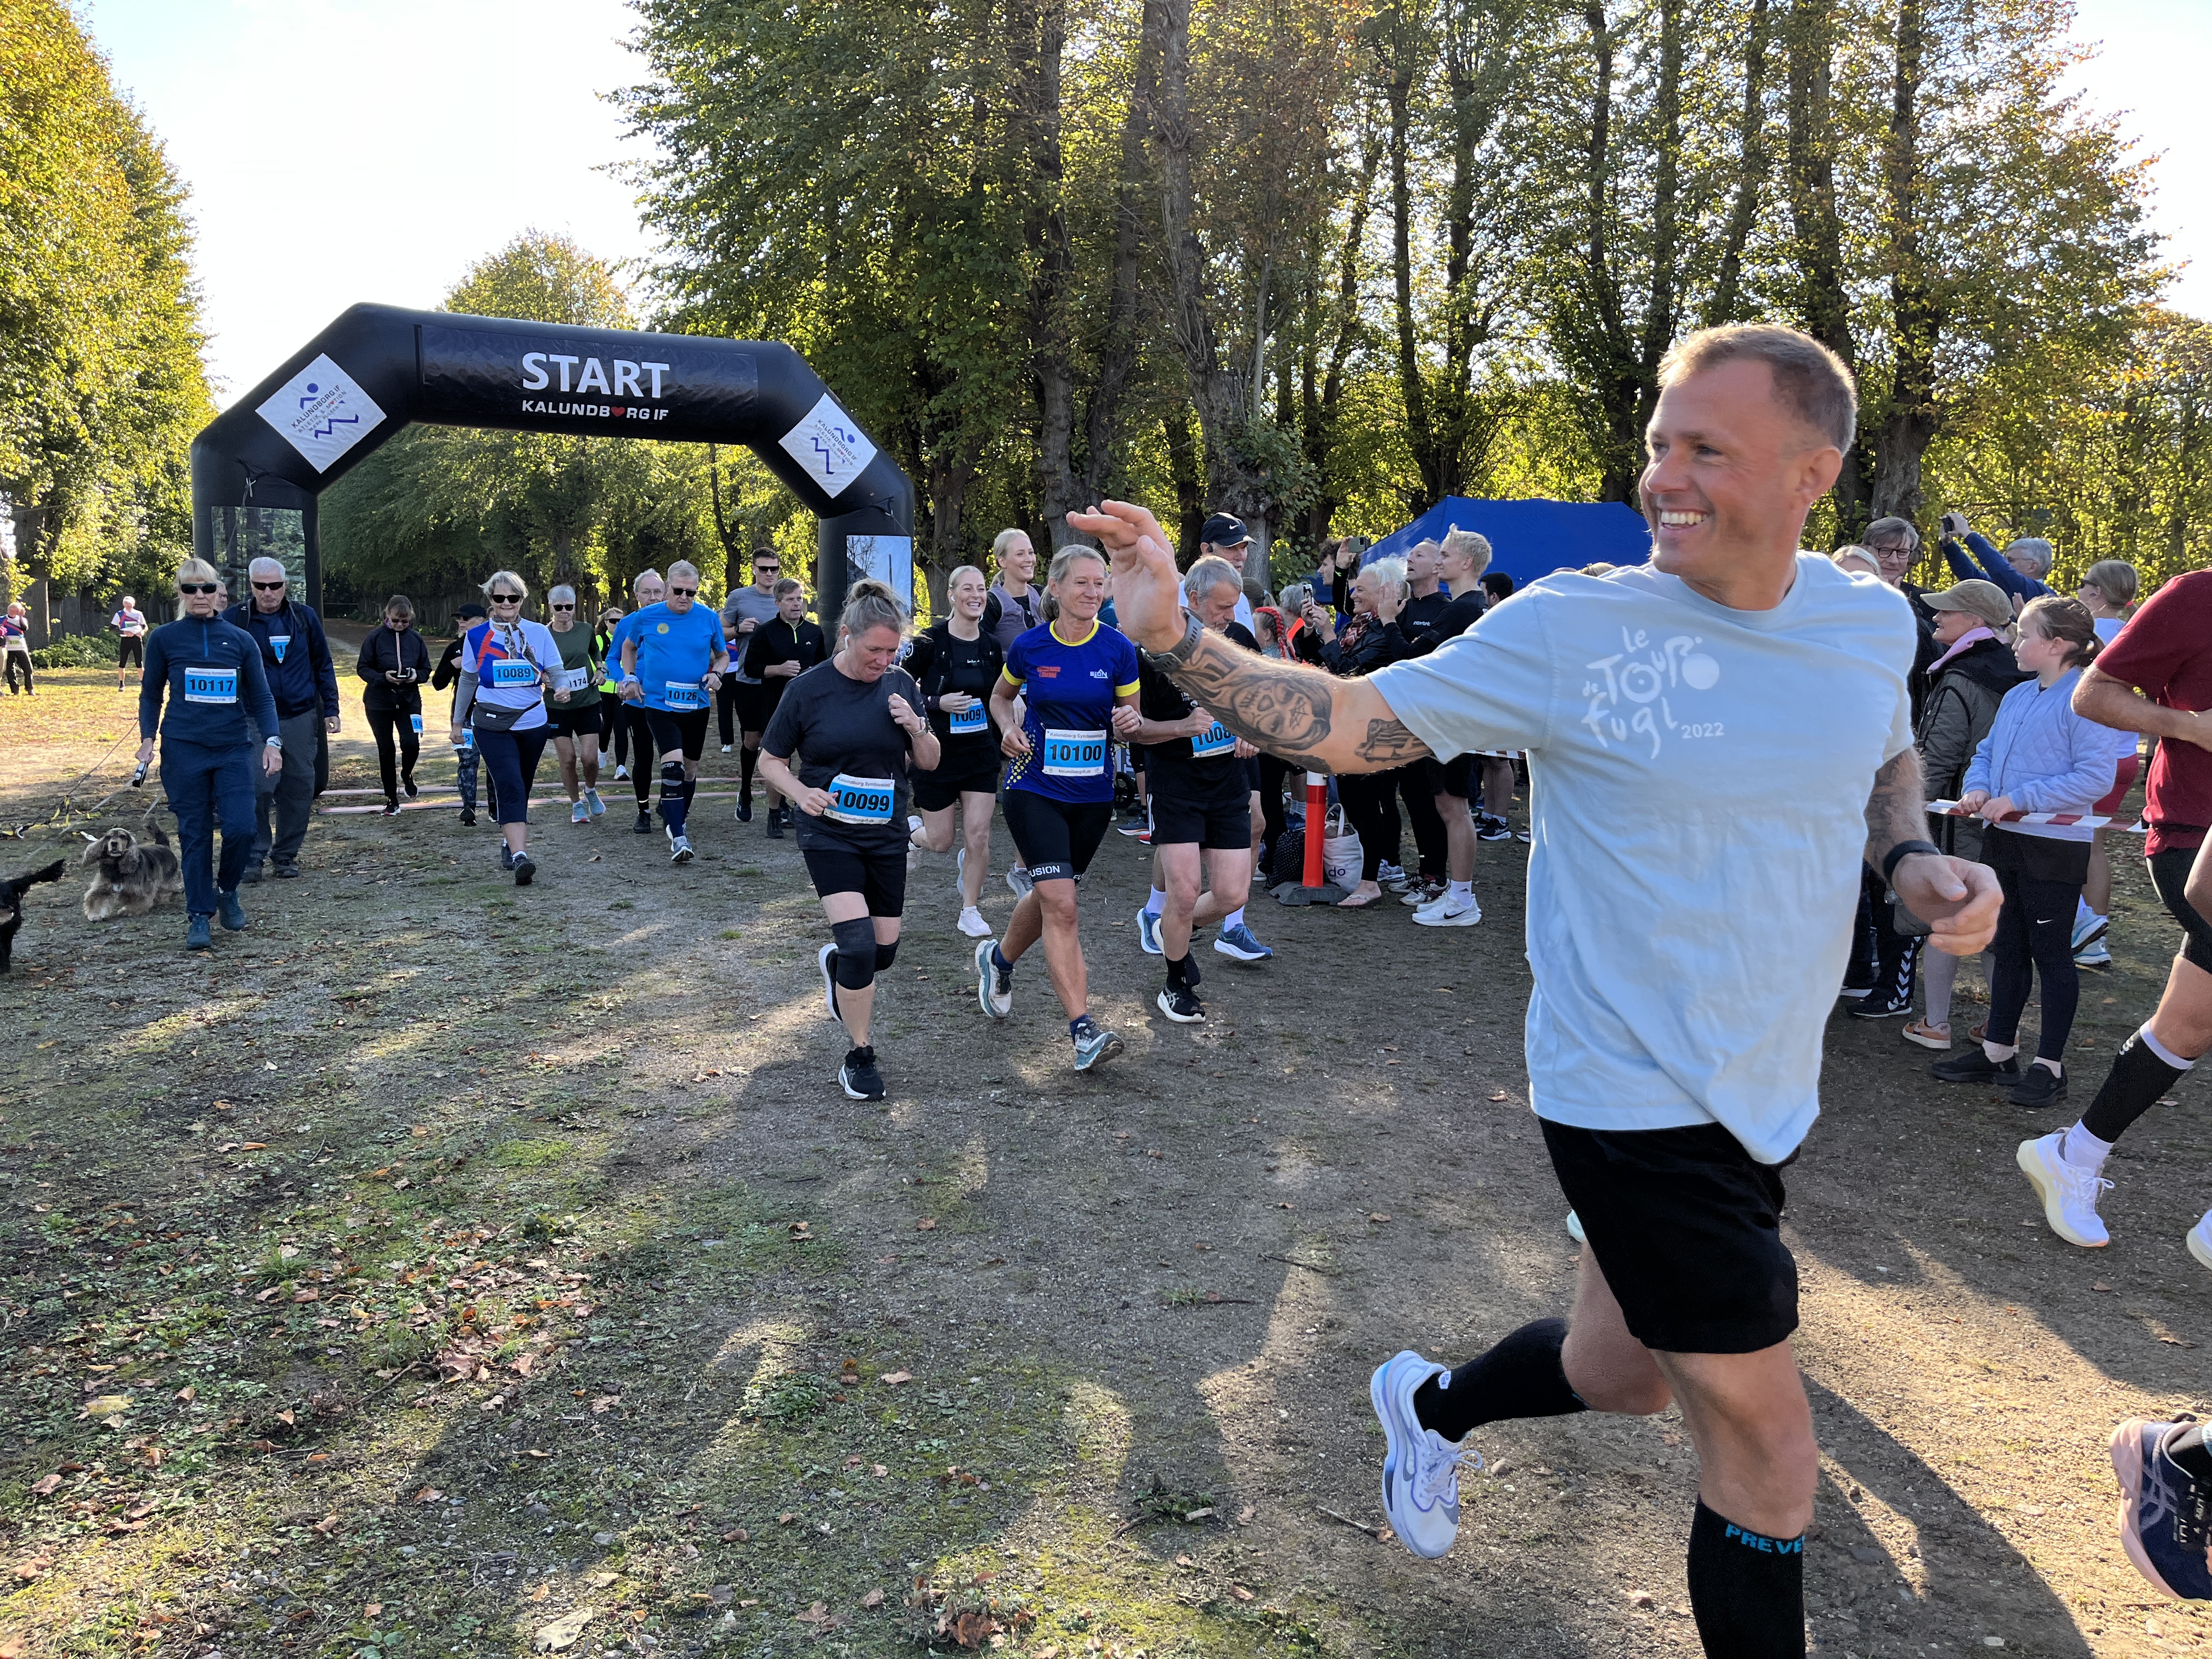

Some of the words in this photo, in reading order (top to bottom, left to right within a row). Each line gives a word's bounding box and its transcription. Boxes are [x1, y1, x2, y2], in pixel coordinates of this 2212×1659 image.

[522, 351, 670, 398] START
[291, 390, 335, 428] KALUNDBORG
[653, 409, 669, 421] IF
[298, 414, 319, 433] ATLETIK
[814, 424, 831, 442] ATLETIK
[817, 419, 853, 456] KALUNDBORG
[496, 667, 531, 679] 10089
[189, 678, 234, 692] 10117
[1681, 721, 1725, 739] 2022
[1049, 744, 1102, 761] 10100
[833, 789, 890, 812] 10099
